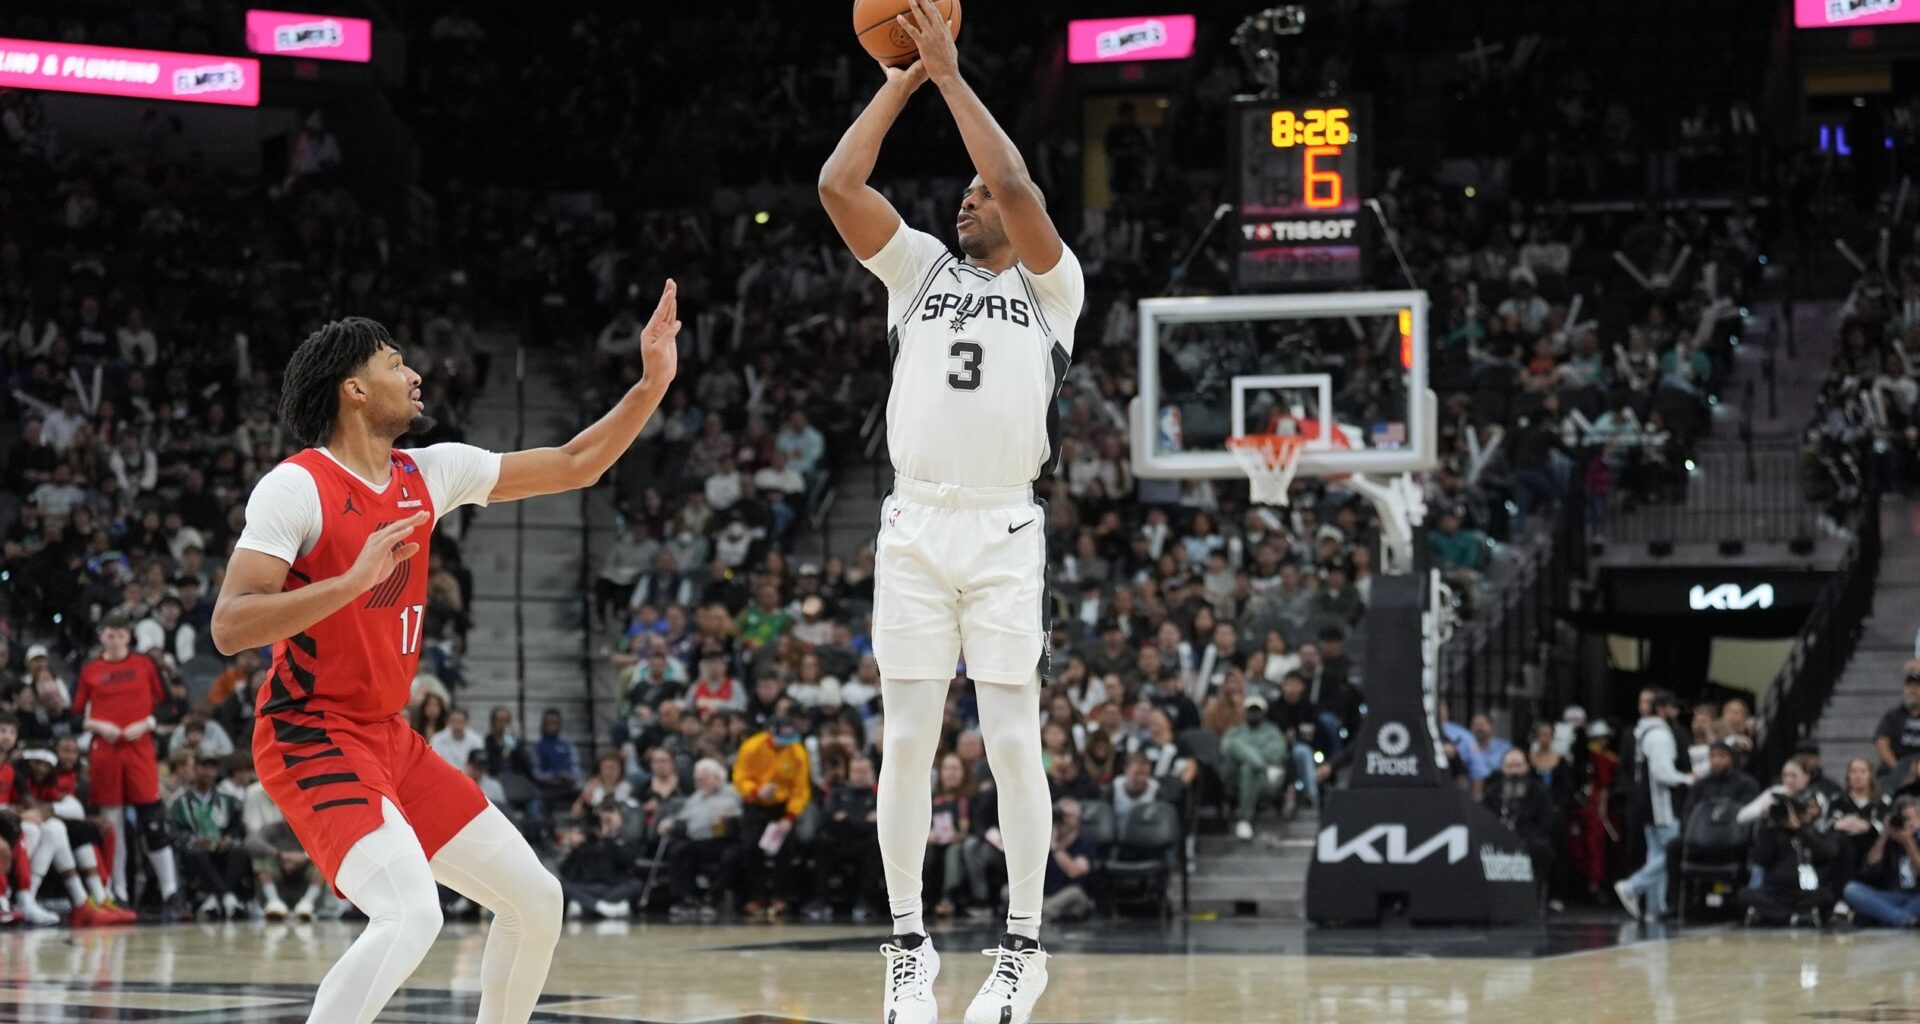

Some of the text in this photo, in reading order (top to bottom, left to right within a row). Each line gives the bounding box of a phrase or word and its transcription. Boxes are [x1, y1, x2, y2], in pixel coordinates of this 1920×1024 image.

[1271, 109, 1350, 147] 8:26
[1304, 145, 1342, 208] 6
[1273, 219, 1356, 240] TISSOT
[922, 293, 1029, 331] SPURS
[946, 339, 985, 392] 3
[400, 604, 424, 655] 17
[1366, 752, 1419, 775] Frost
